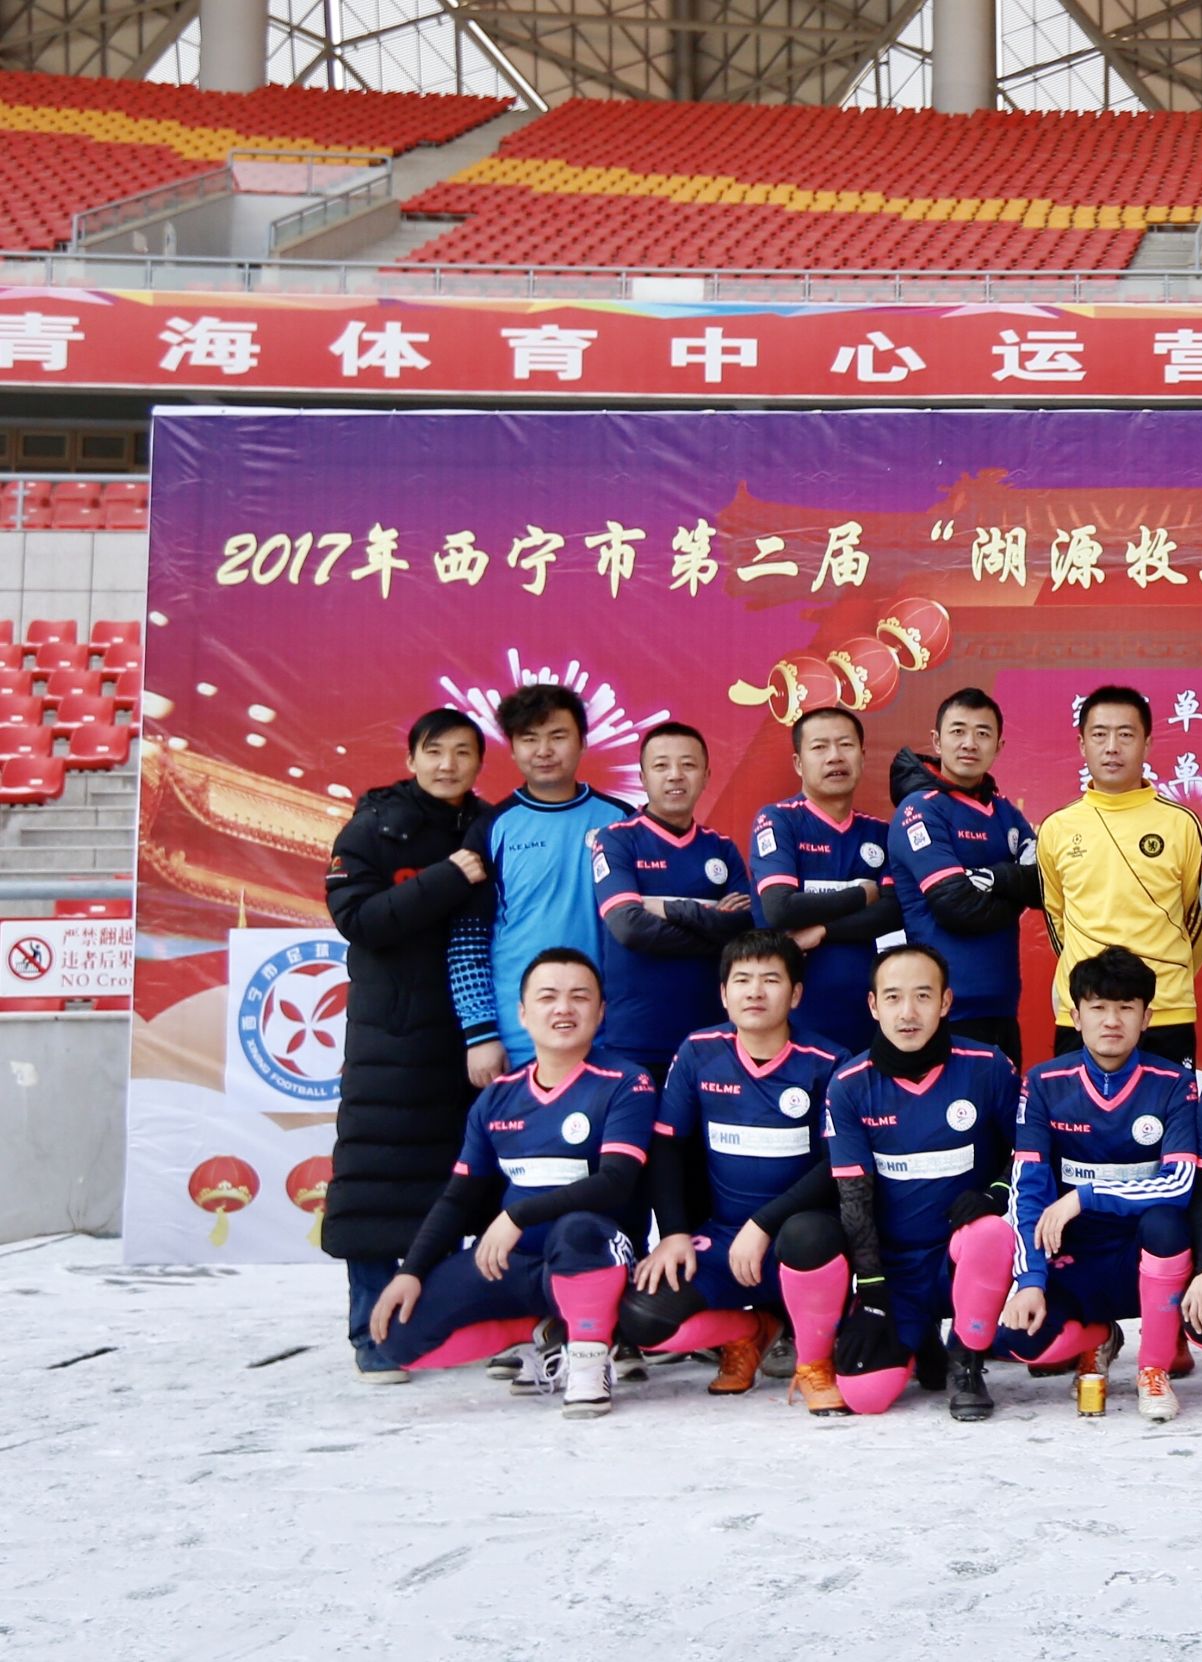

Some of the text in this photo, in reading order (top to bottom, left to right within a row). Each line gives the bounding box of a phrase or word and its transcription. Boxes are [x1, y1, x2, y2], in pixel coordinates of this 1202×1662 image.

[958, 830, 987, 840] KELME
[508, 841, 546, 852] KELME
[799, 843, 831, 853] KELME
[636, 860, 667, 869] ELME
[61, 972, 132, 988] NO Cro
[271, 1071, 328, 1097] FOOTBALL
[701, 1081, 741, 1095] KELME
[1050, 1120, 1091, 1133] KELME
